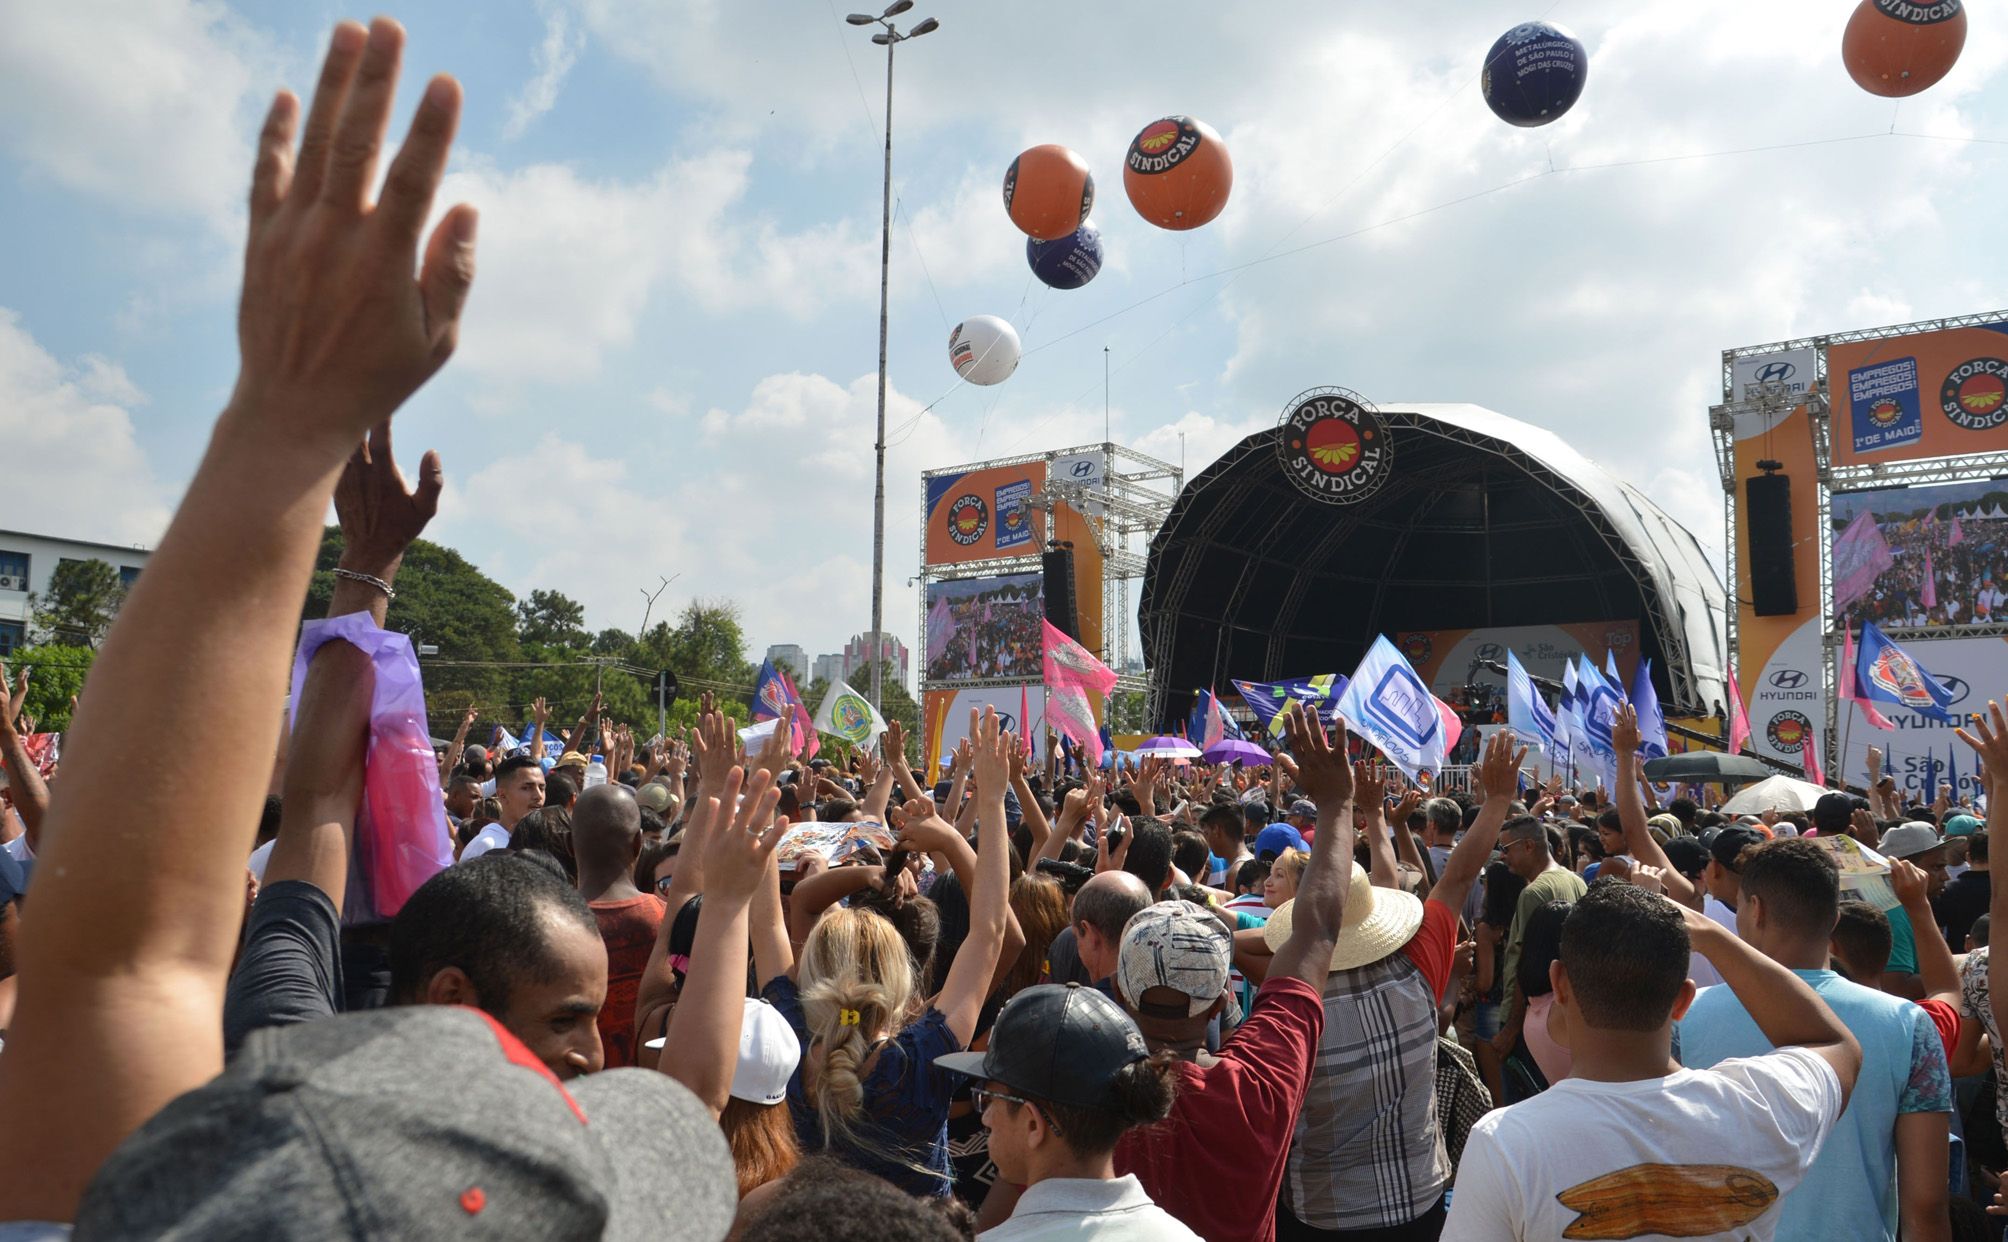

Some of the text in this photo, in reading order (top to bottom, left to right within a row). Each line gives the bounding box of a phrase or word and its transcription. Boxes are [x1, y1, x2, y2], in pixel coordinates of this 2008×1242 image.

[1517, 57, 1528, 66] DE
[1528, 51, 1545, 61] SÃO
[1545, 50, 1570, 58] PAULO
[1516, 65, 1537, 78] MOGI
[1537, 61, 1552, 70] DAS
[1130, 136, 1196, 171] SINDICAL
[1851, 360, 1915, 383] EMPREGOS!
[1852, 370, 1916, 392] EMPREGOS!
[1853, 379, 1917, 402] EMPREGOS!
[1292, 401, 1361, 432] FORÇA
[1865, 434, 1881, 445] DE
[1885, 425, 1915, 440] MAIO
[1292, 447, 1381, 492] SINDICAL
[952, 496, 983, 513] FORÇA
[948, 521, 987, 544] SINDICAL
[1760, 691, 1817, 700] HYUNDAI
[1771, 711, 1805, 725] FORÇA
[1904, 755, 1945, 773] São
